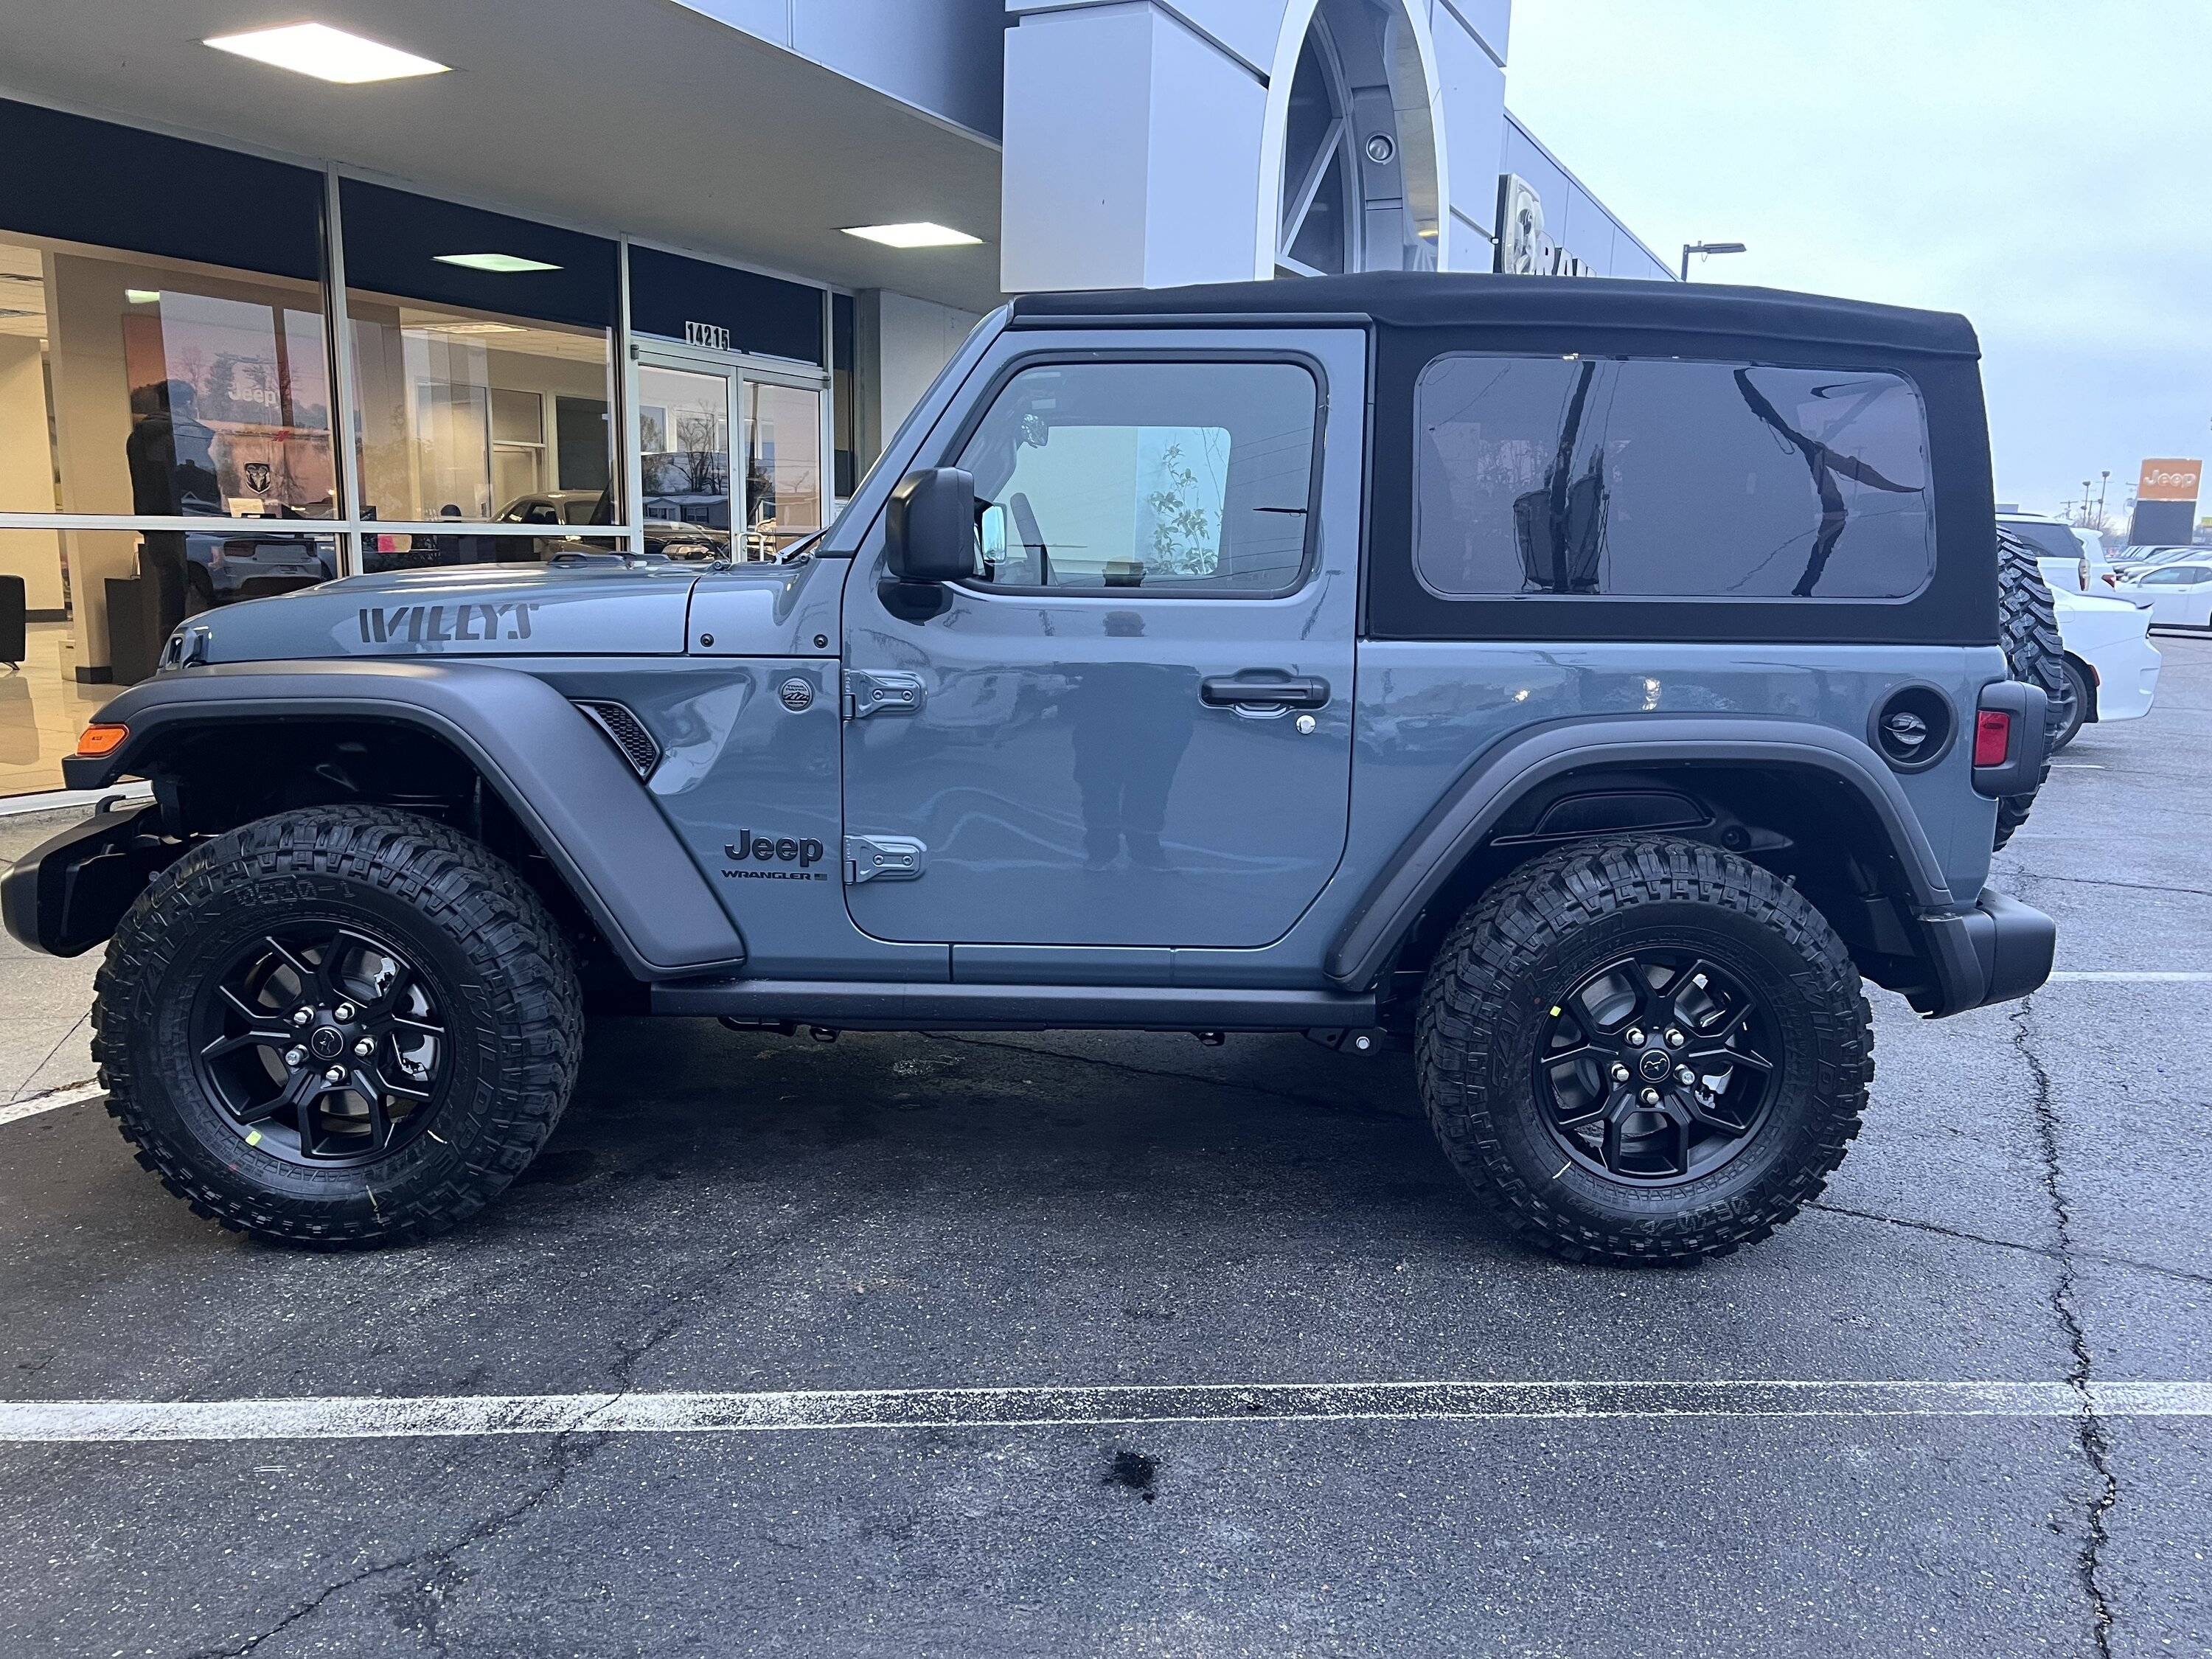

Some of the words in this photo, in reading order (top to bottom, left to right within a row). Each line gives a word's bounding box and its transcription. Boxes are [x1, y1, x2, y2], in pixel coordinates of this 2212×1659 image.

[687, 323, 728, 351] 14215
[228, 382, 276, 407] Jeep
[2143, 470, 2197, 488] Jeep
[359, 603, 540, 643] WILLYS
[724, 827, 824, 868] Jeep
[720, 869, 811, 880] WRANGLER
